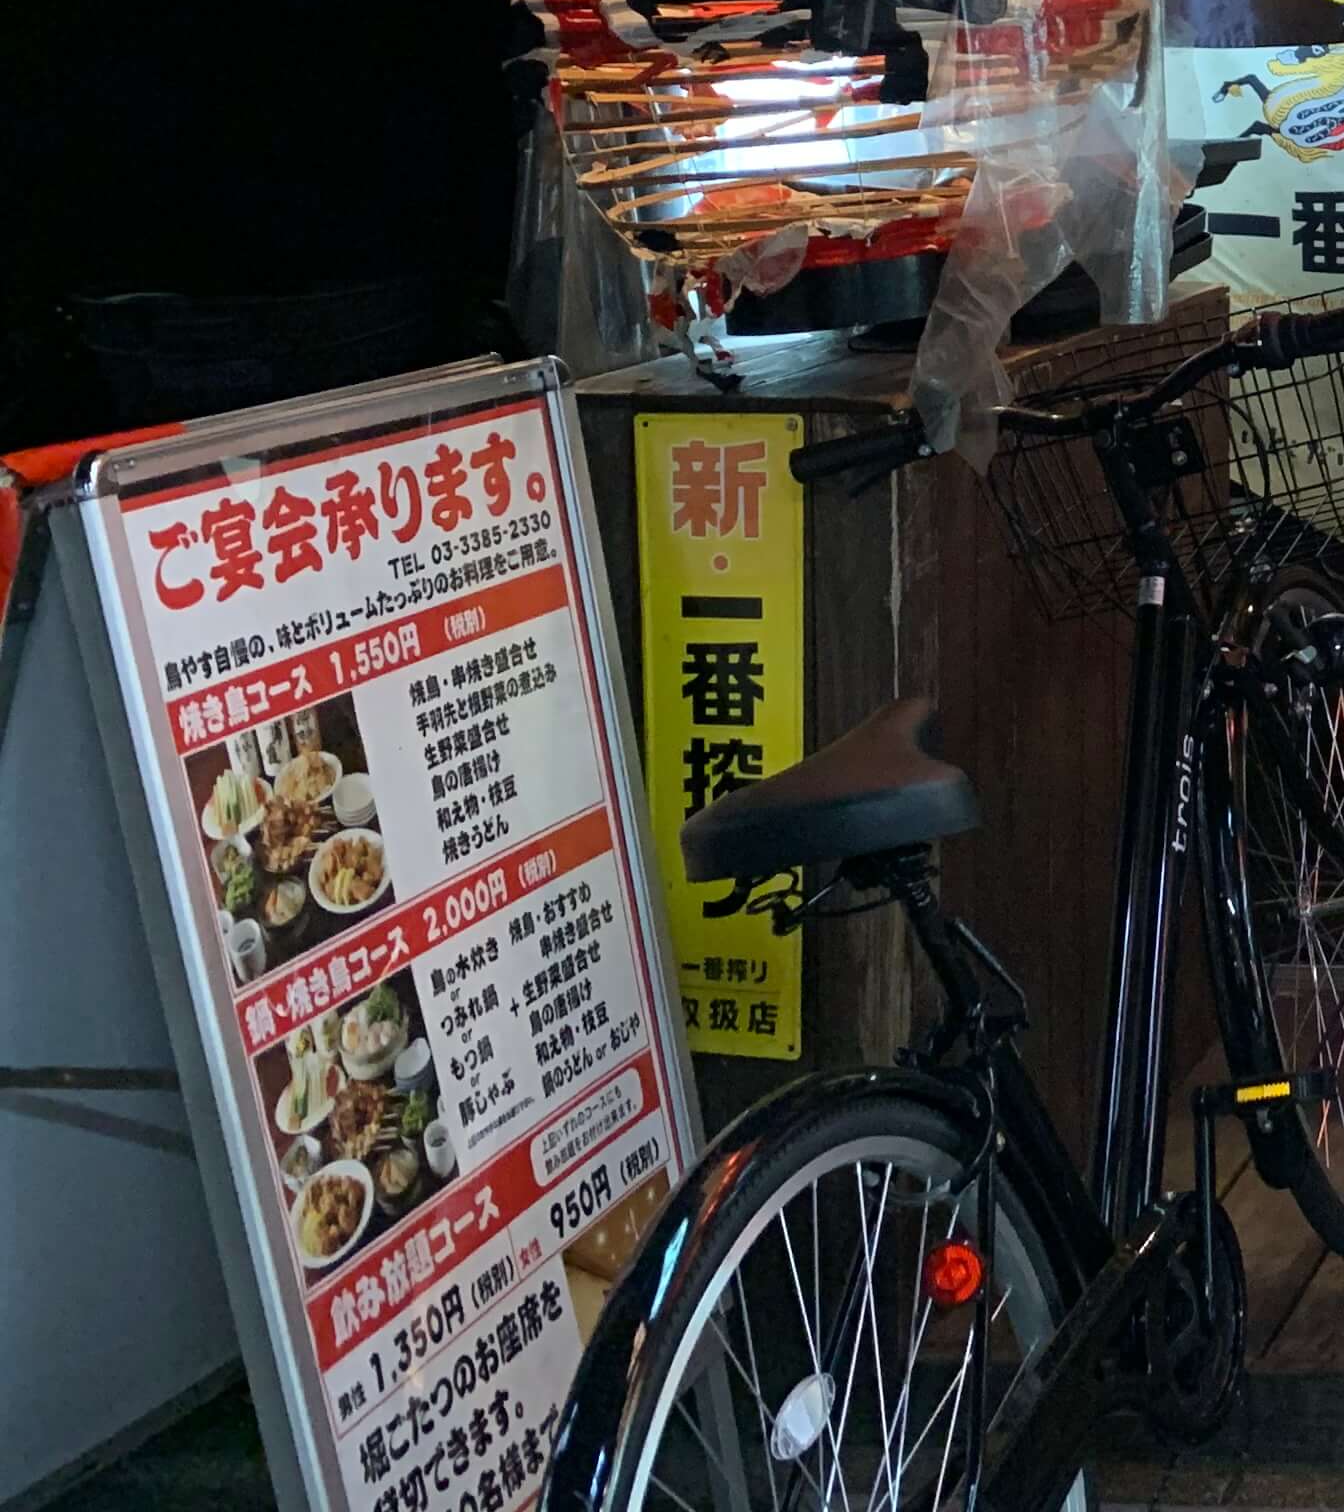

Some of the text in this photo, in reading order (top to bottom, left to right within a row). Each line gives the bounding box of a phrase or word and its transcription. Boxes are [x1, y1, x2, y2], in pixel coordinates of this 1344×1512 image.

[149, 432, 546, 610] ご宴会承ります。
[388, 510, 552, 580] TEL 03-3385-2330
[179, 665, 314, 745] 焼き鳥コース
[329, 622, 422, 685] 1,550円
[409, 636, 538, 708] 焼鳥・串焼き盛合せ
[424, 713, 511, 771] 生野菜盛合せ
[436, 774, 518, 833] 和え物・枝豆
[1171, 733, 1195, 853] trois
[442, 814, 510, 865] 焼きうどん
[422, 867, 508, 941] 2,000円
[509, 881, 592, 946] 焼鳥・おすすめ
[539, 901, 614, 959] 串焼き盛合せ
[430, 937, 500, 999] 鳥の水炊き
[449, 987, 461, 1002] or
[522, 940, 601, 1007] 生野菜盛合せ
[681, 956, 768, 984] 一番搾り
[440, 983, 500, 1038] つみれ鍋
[461, 1028, 473, 1044] or
[534, 1002, 610, 1066] 和え物・枝豆
[450, 1035, 495, 1081] もつ鍋
[470, 1072, 481, 1088] or
[541, 1051, 594, 1099] 鍋のうどん
[459, 1067, 516, 1129] 豚しゃぶ
[518, 1237, 544, 1267] 女性
[550, 1163, 612, 1239] 950円
[330, 1185, 500, 1348] 飲み放題コース
[338, 1382, 367, 1421] 男性
[369, 1284, 465, 1393] 1,350円
